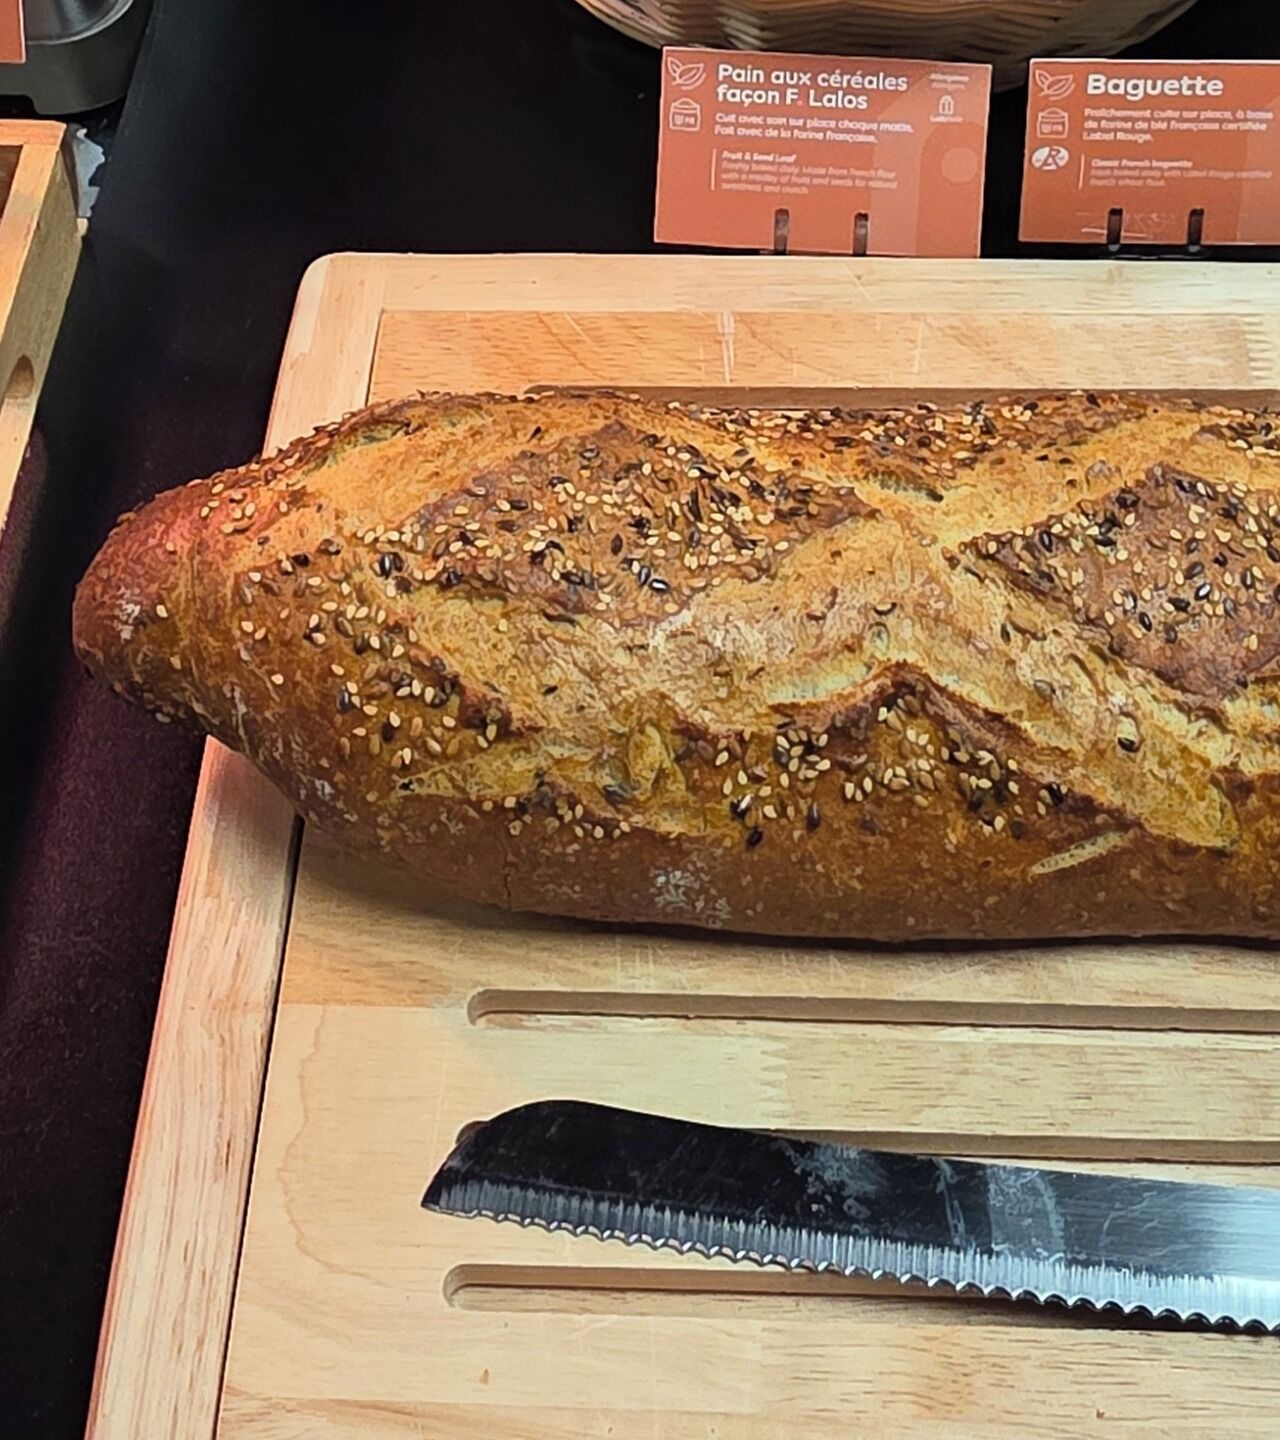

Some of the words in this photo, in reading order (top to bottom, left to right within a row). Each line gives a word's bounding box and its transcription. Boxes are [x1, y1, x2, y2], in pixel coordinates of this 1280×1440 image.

[718, 64, 764, 83] Pain
[771, 70, 811, 85] aux
[817, 69, 908, 91] céréales
[1087, 74, 1224, 101] Baguette
[717, 84, 780, 108] façon
[785, 88, 803, 106] F.
[809, 89, 868, 109] Lalos
